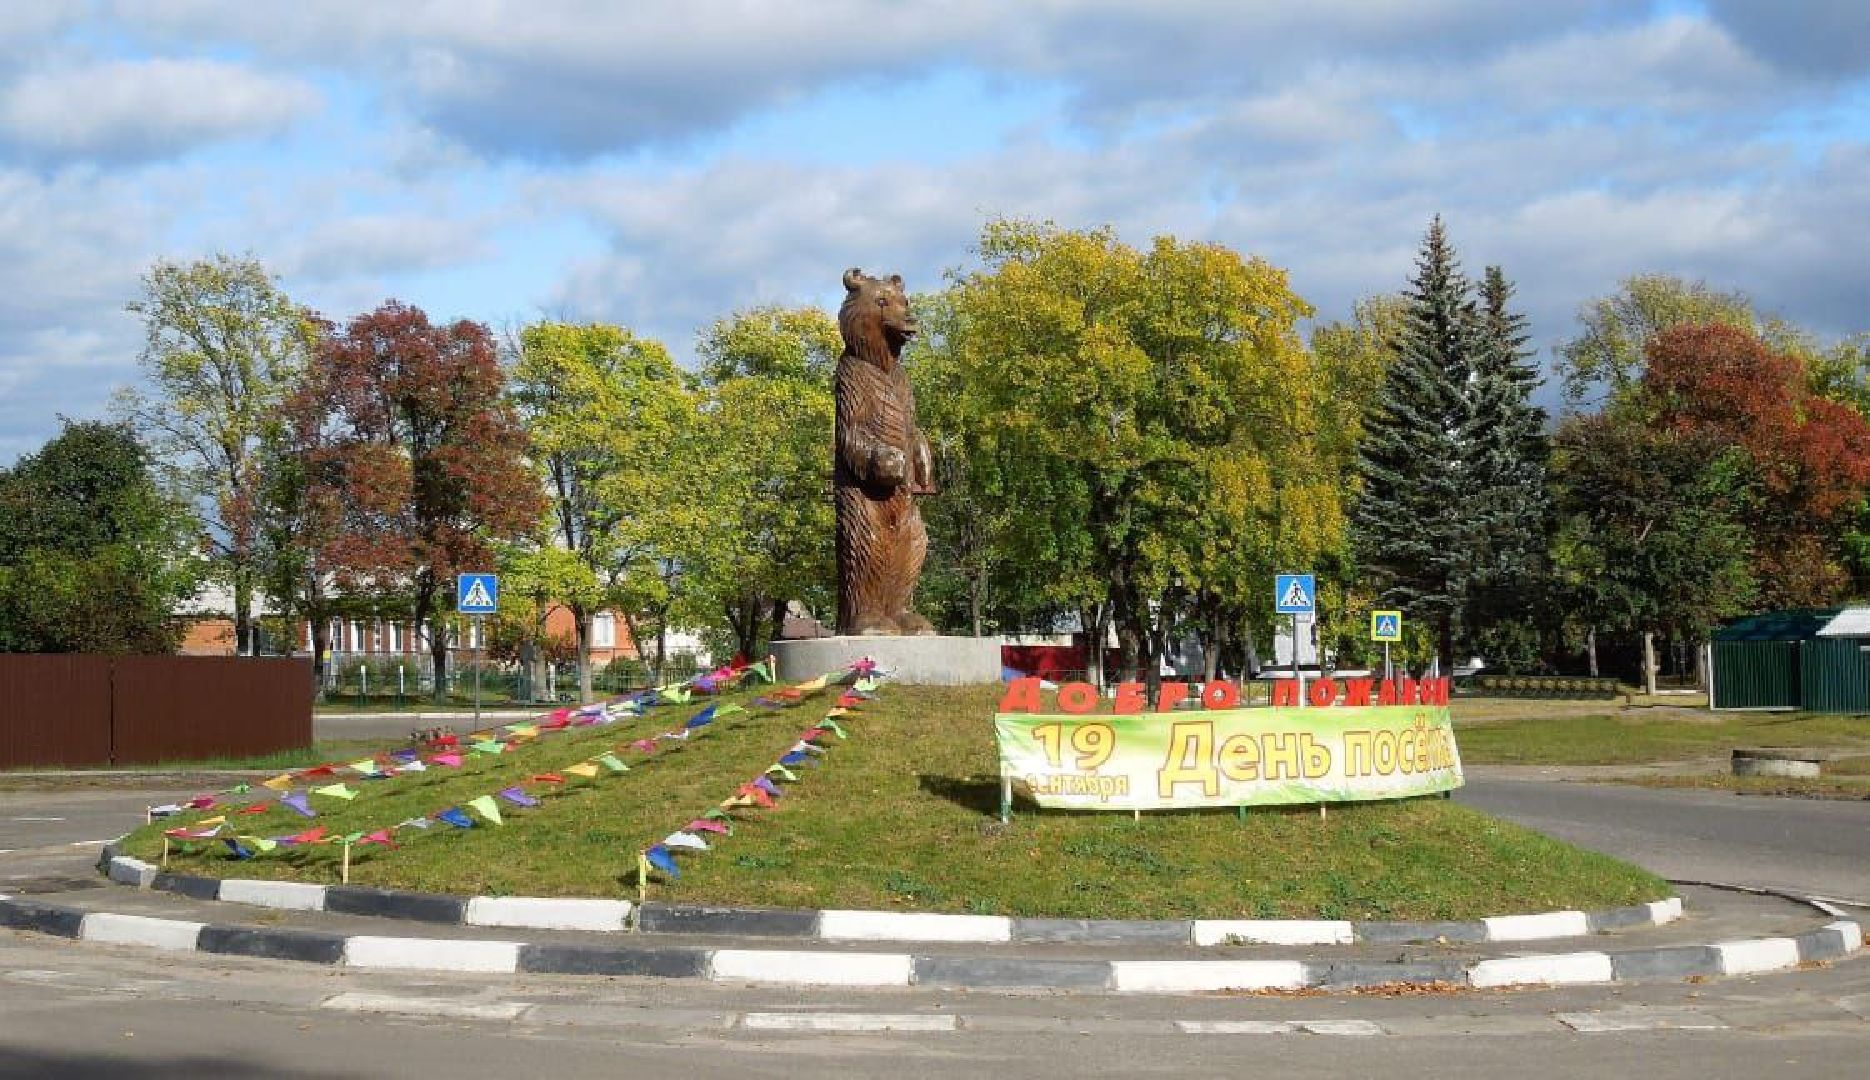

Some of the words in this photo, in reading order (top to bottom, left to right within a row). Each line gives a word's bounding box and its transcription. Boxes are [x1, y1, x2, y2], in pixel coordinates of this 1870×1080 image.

[999, 677, 1239, 714] ДОБРО
[1031, 722, 1115, 770] 19
[1157, 720, 1331, 797] День
